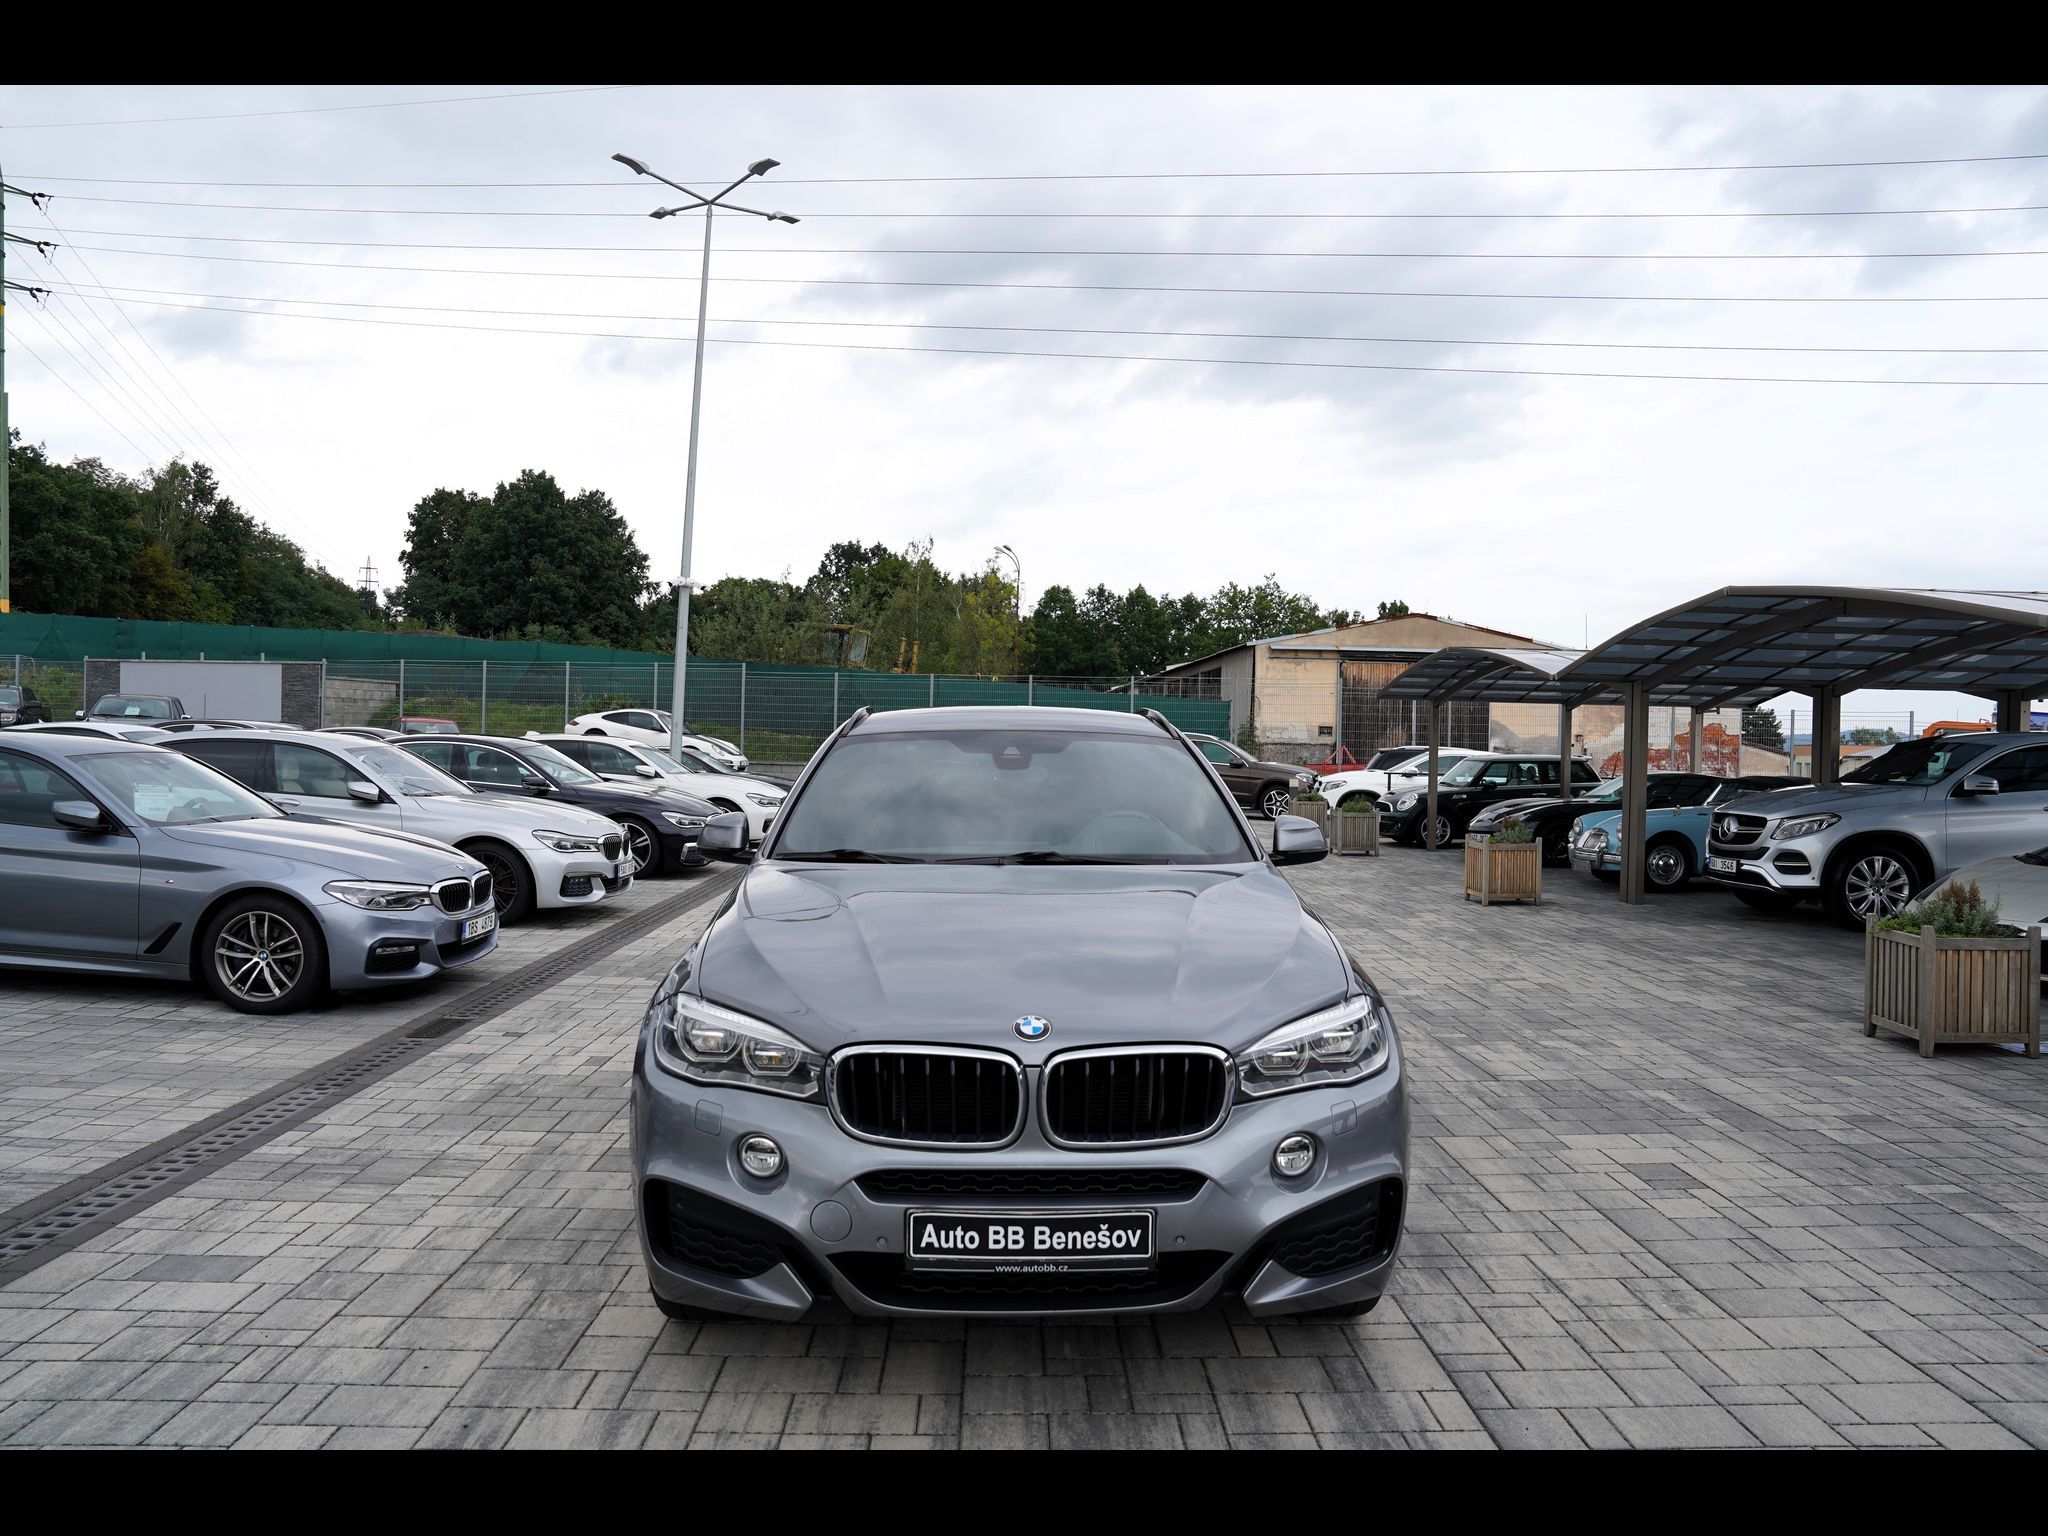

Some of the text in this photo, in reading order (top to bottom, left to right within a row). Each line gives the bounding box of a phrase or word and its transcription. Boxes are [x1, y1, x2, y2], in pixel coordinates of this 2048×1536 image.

[920, 1223, 1142, 1250] Auto BB Benešov
[995, 1263, 1068, 1273] www.autobb.cz
